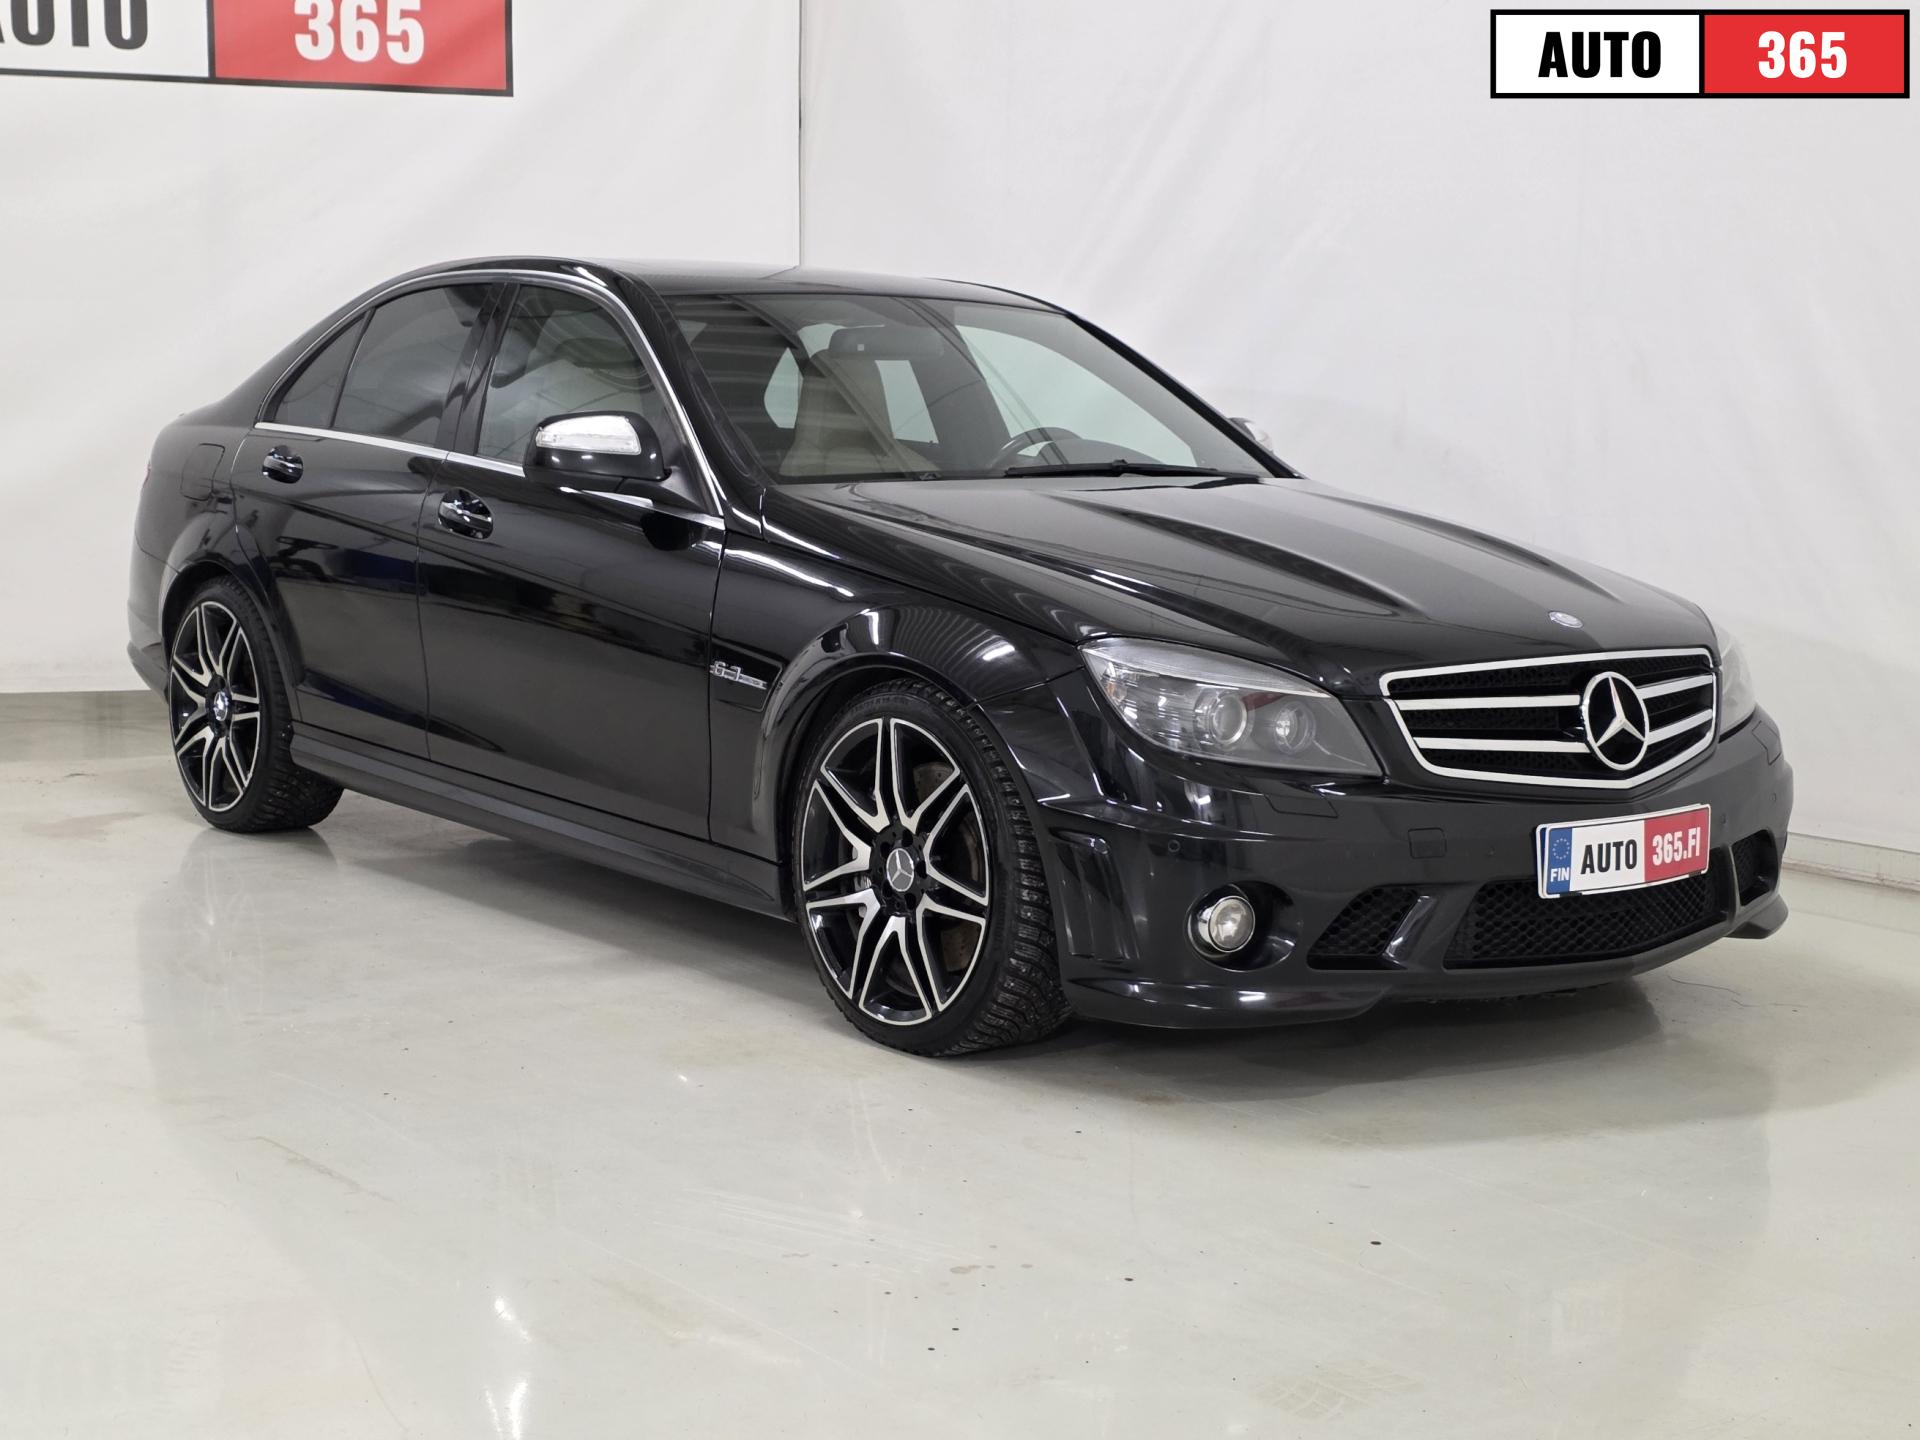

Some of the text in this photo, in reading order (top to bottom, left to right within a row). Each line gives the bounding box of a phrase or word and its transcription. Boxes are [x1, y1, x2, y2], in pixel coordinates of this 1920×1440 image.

[0, 0, 425, 65] UTO 365
[1550, 867, 1570, 883] FIN
[1580, 826, 1701, 875] AUTO 365.FI
